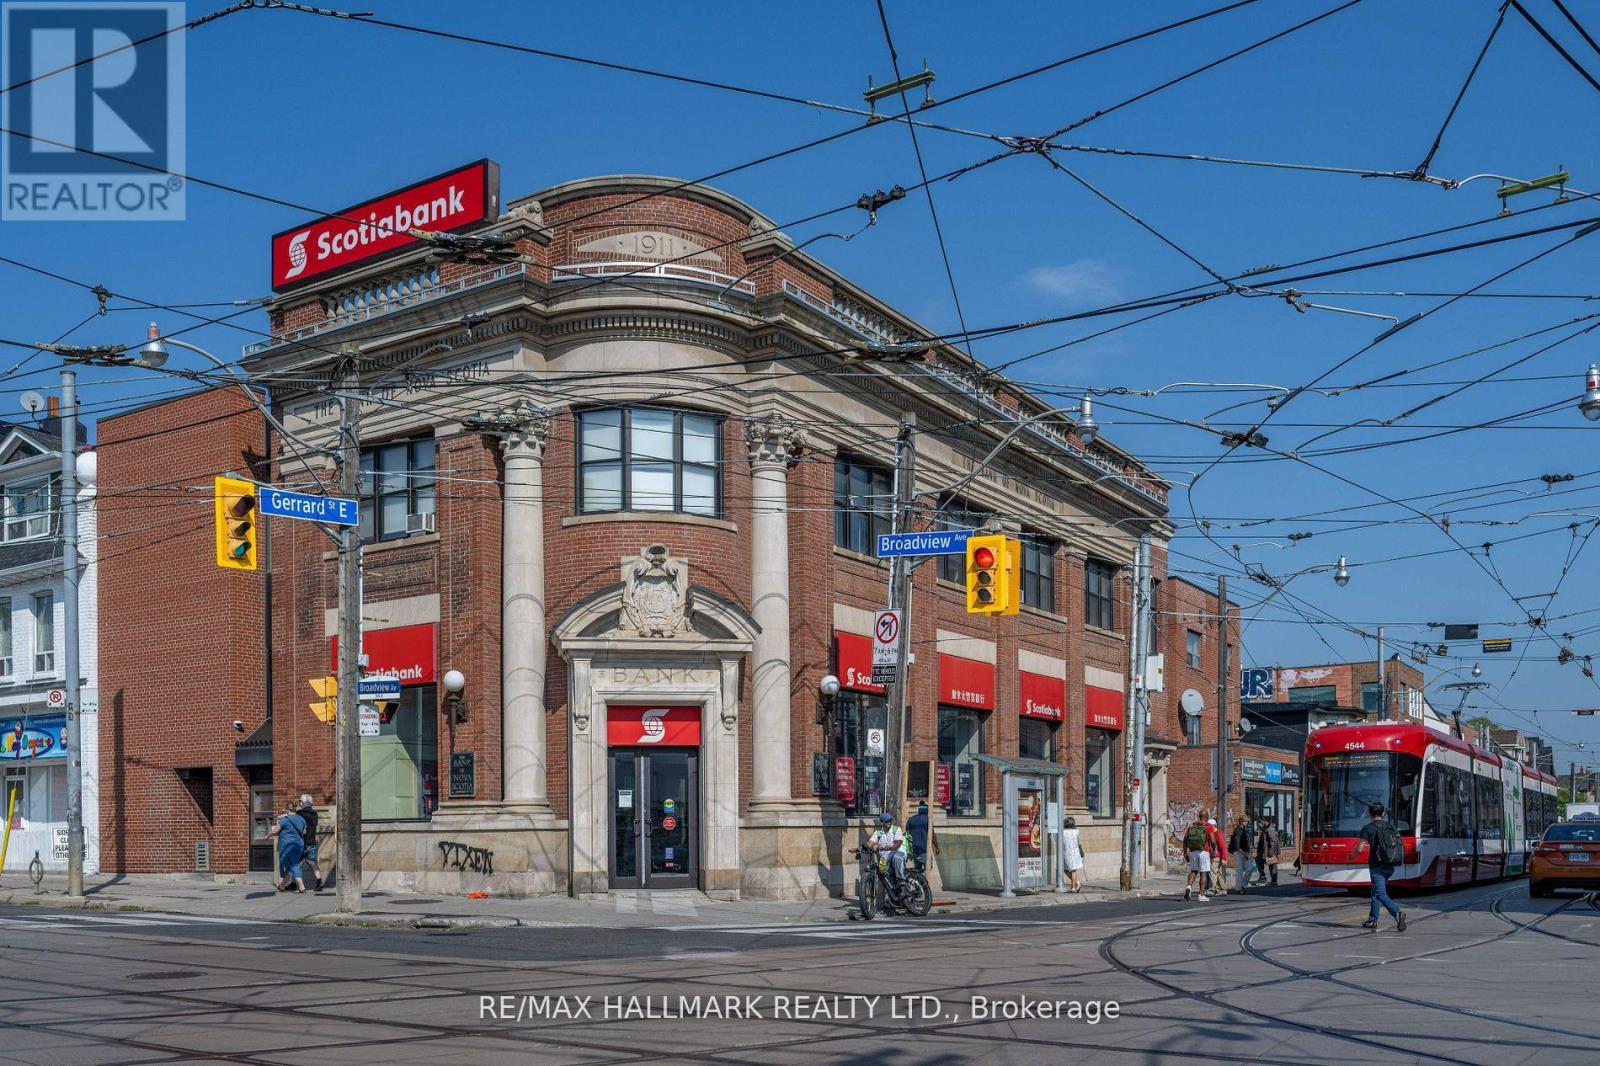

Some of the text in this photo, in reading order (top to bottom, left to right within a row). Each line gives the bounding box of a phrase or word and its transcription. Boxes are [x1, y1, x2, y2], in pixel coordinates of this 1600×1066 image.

[317, 185, 465, 261] Scotiabank
[634, 235, 673, 257] 1911
[314, 402, 334, 420] THE
[271, 493, 348, 518] Gerrard St E
[881, 533, 967, 552] Broadview Ave
[613, 666, 698, 685] BANK
[359, 683, 390, 692] Broadview
[1344, 742, 1365, 750] 4544
